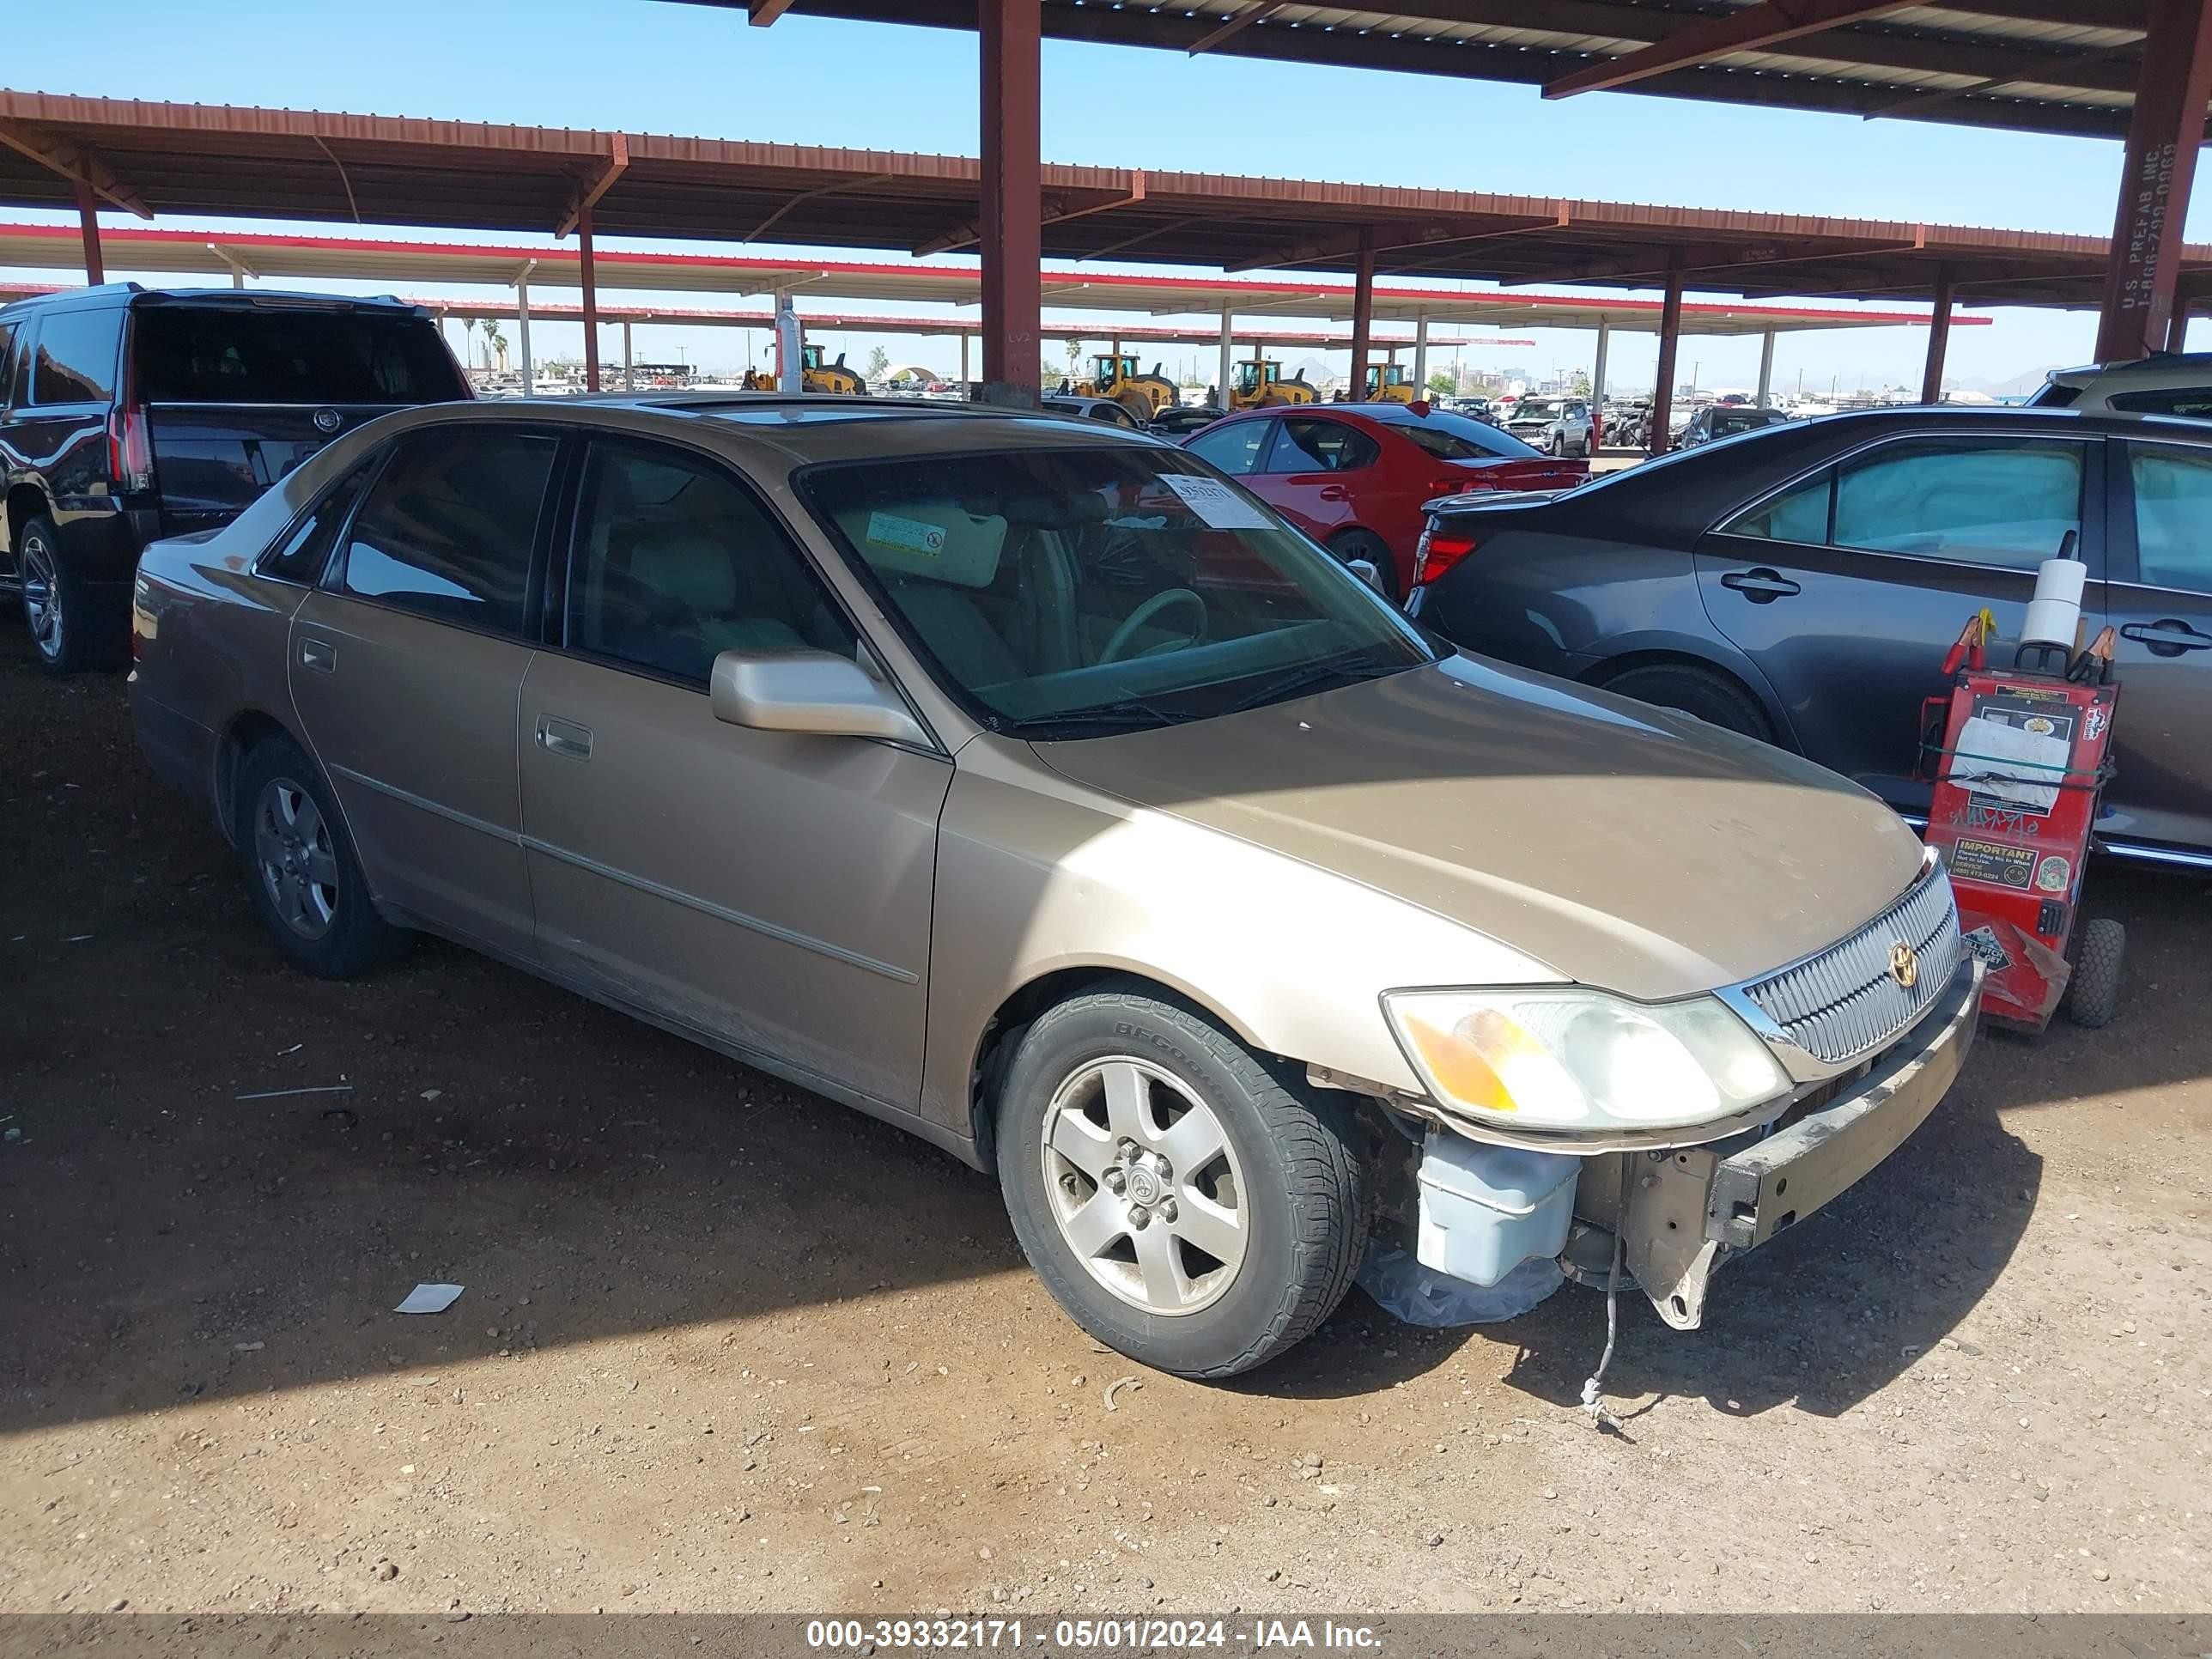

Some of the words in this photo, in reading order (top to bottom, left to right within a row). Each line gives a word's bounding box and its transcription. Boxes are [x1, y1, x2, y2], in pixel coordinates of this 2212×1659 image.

[2130, 191, 2153, 263] PREFAB
[2143, 144, 2161, 180] INC.
[2084, 720, 2094, 739] SUSHI
[1958, 849, 1980, 858] Please
[1960, 841, 2034, 860] IMPORTANT
[1955, 860, 1984, 870] SERVICE
[1979, 945, 2003, 958] BITCH
[1986, 955, 2002, 964] GET
